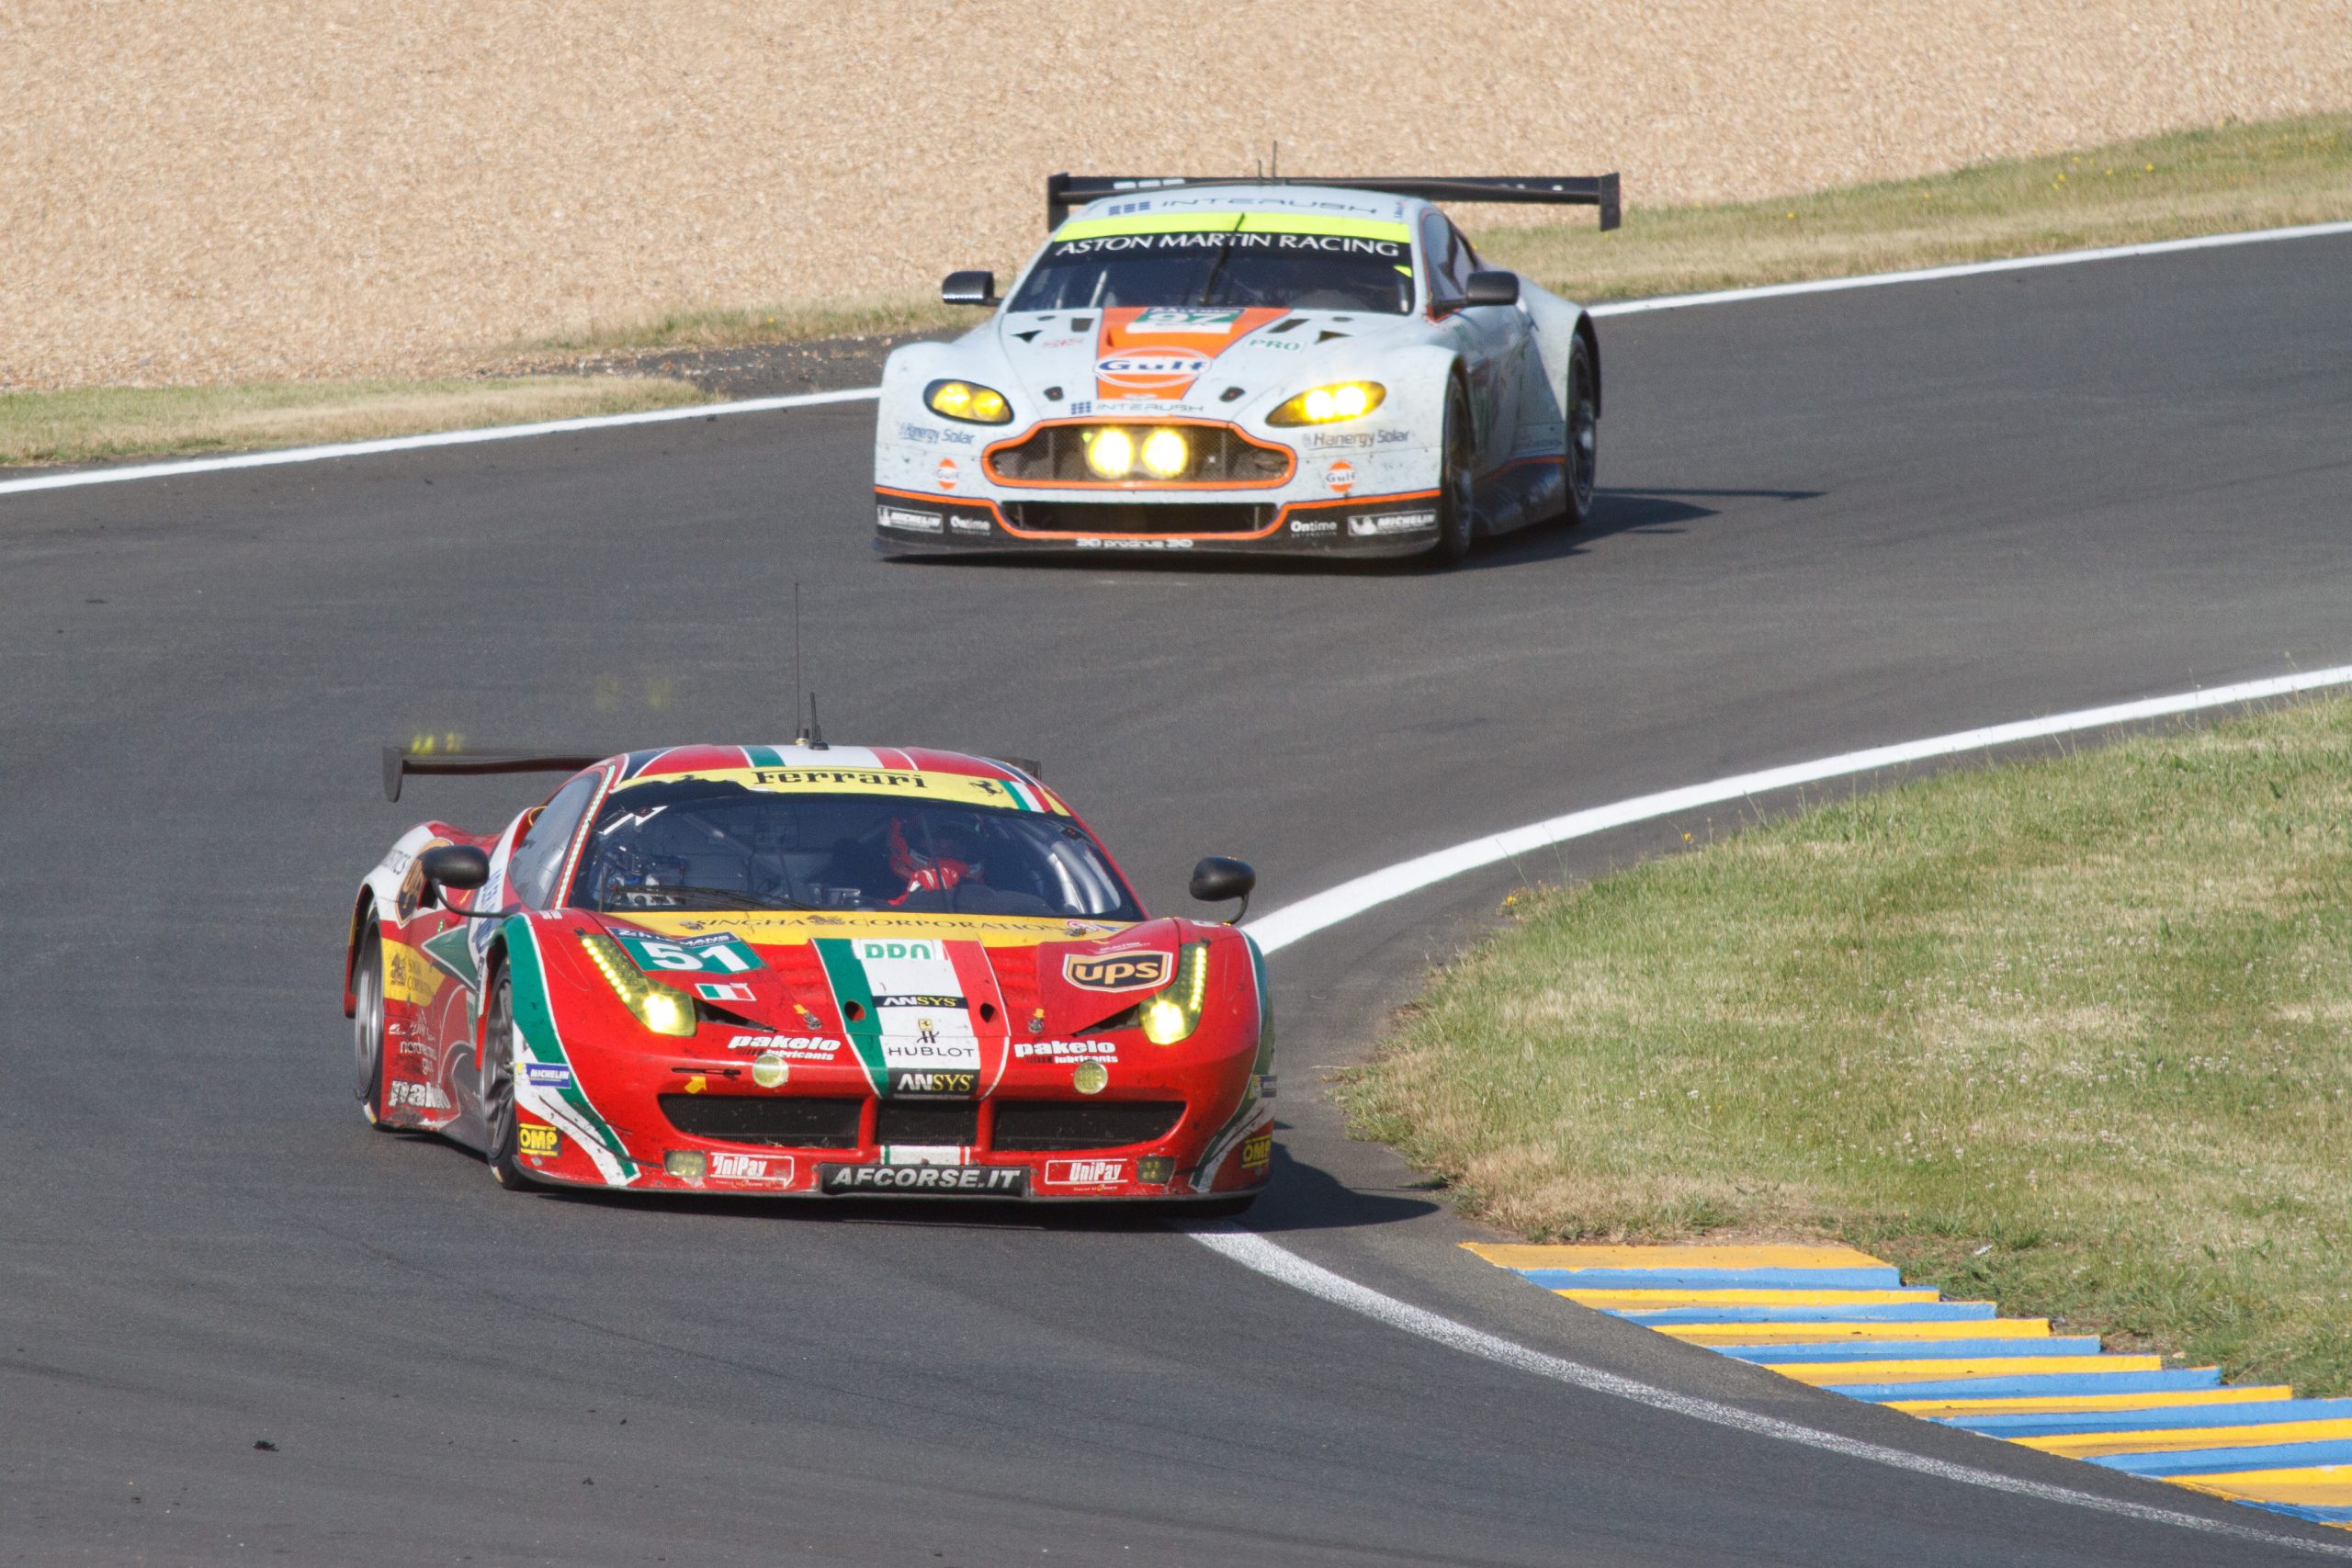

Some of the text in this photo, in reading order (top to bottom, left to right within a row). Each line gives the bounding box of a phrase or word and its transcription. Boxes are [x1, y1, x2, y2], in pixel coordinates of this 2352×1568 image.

[1056, 233, 1398, 256] ASTON MARTIN RACING
[1250, 339, 1300, 350] PRO
[1099, 359, 1206, 371] Gulf
[1314, 429, 1409, 447] Hanergy Solar
[1326, 472, 1355, 482] Gulf
[1290, 520, 1337, 532] Ontime
[752, 770, 927, 788] Ferrari
[639, 942, 750, 972] 51
[1075, 962, 1159, 985] ups
[883, 997, 956, 1007] ANSYS
[728, 1035, 841, 1051] pakelo
[1013, 1040, 1116, 1057] pakelo
[888, 1047, 975, 1057] HUBLOT
[530, 1068, 570, 1080] MICHELIN
[898, 1074, 974, 1091] ANSYS
[520, 1128, 558, 1150] OMP
[831, 1167, 1021, 1189] AFCORSE.IT
[1069, 1161, 1122, 1181] UniPay
